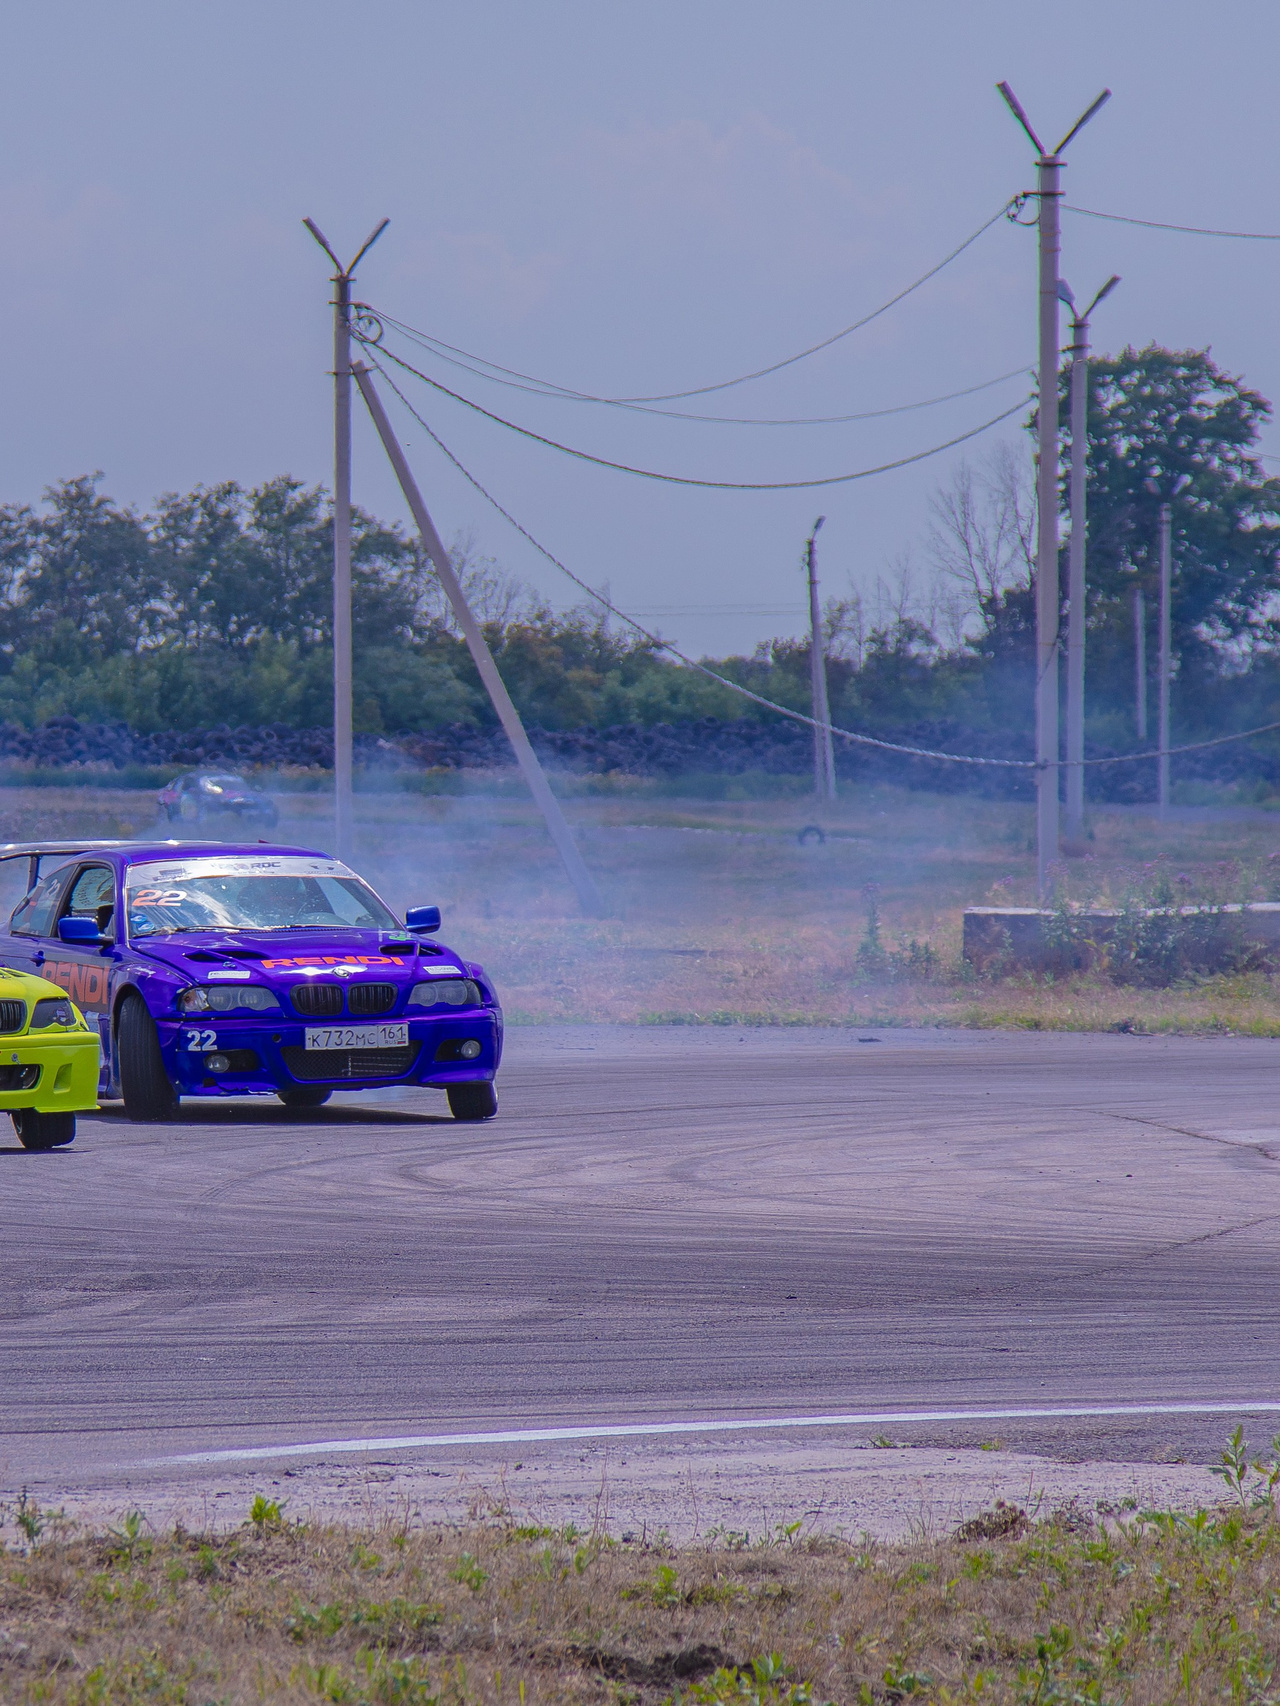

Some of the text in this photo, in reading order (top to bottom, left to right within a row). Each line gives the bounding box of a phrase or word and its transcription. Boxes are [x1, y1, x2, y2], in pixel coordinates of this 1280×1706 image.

[131, 889, 187, 907] 22
[260, 956, 405, 969] RENDI
[186, 1029, 218, 1051] 22
[380, 1026, 404, 1040] 161
